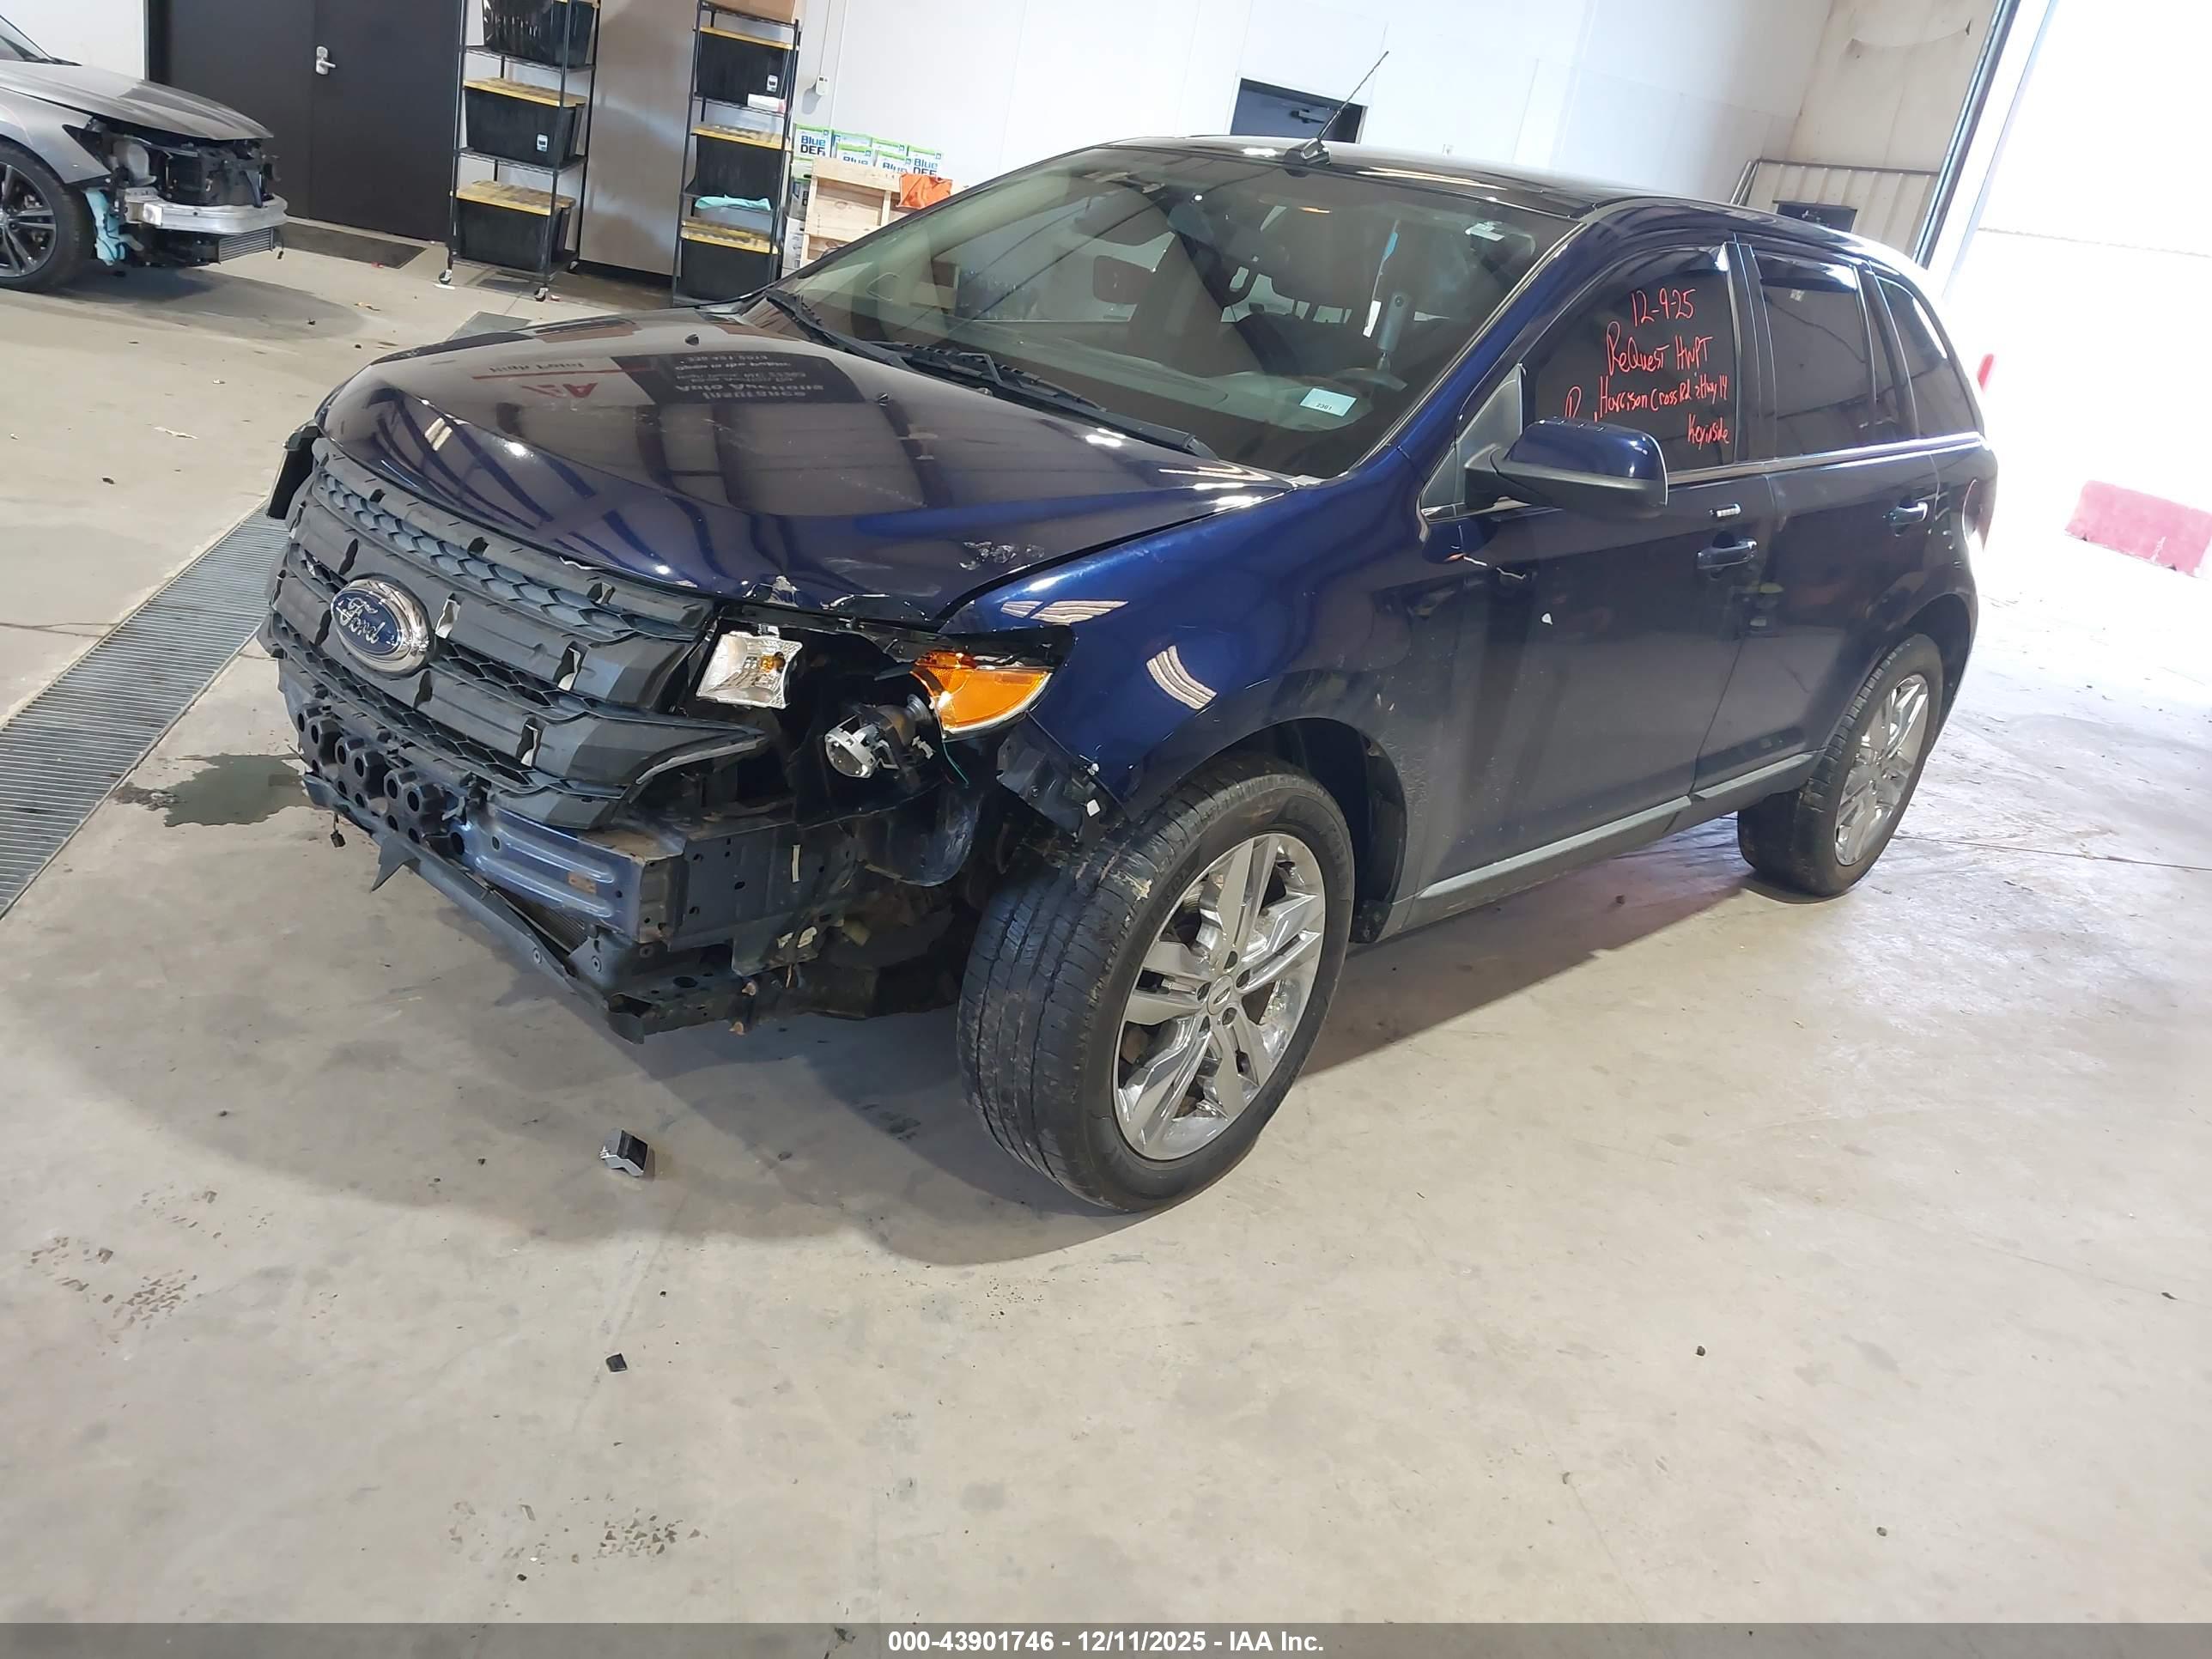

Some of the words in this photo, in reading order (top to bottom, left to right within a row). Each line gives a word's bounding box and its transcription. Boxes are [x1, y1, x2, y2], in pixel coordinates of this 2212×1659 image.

[800, 135, 826, 147] Blue
[800, 144, 825, 156] DEF
[914, 157, 939, 169] Blue
[1632, 288, 1697, 327] 12-9-25
[336, 597, 386, 644] Ford
